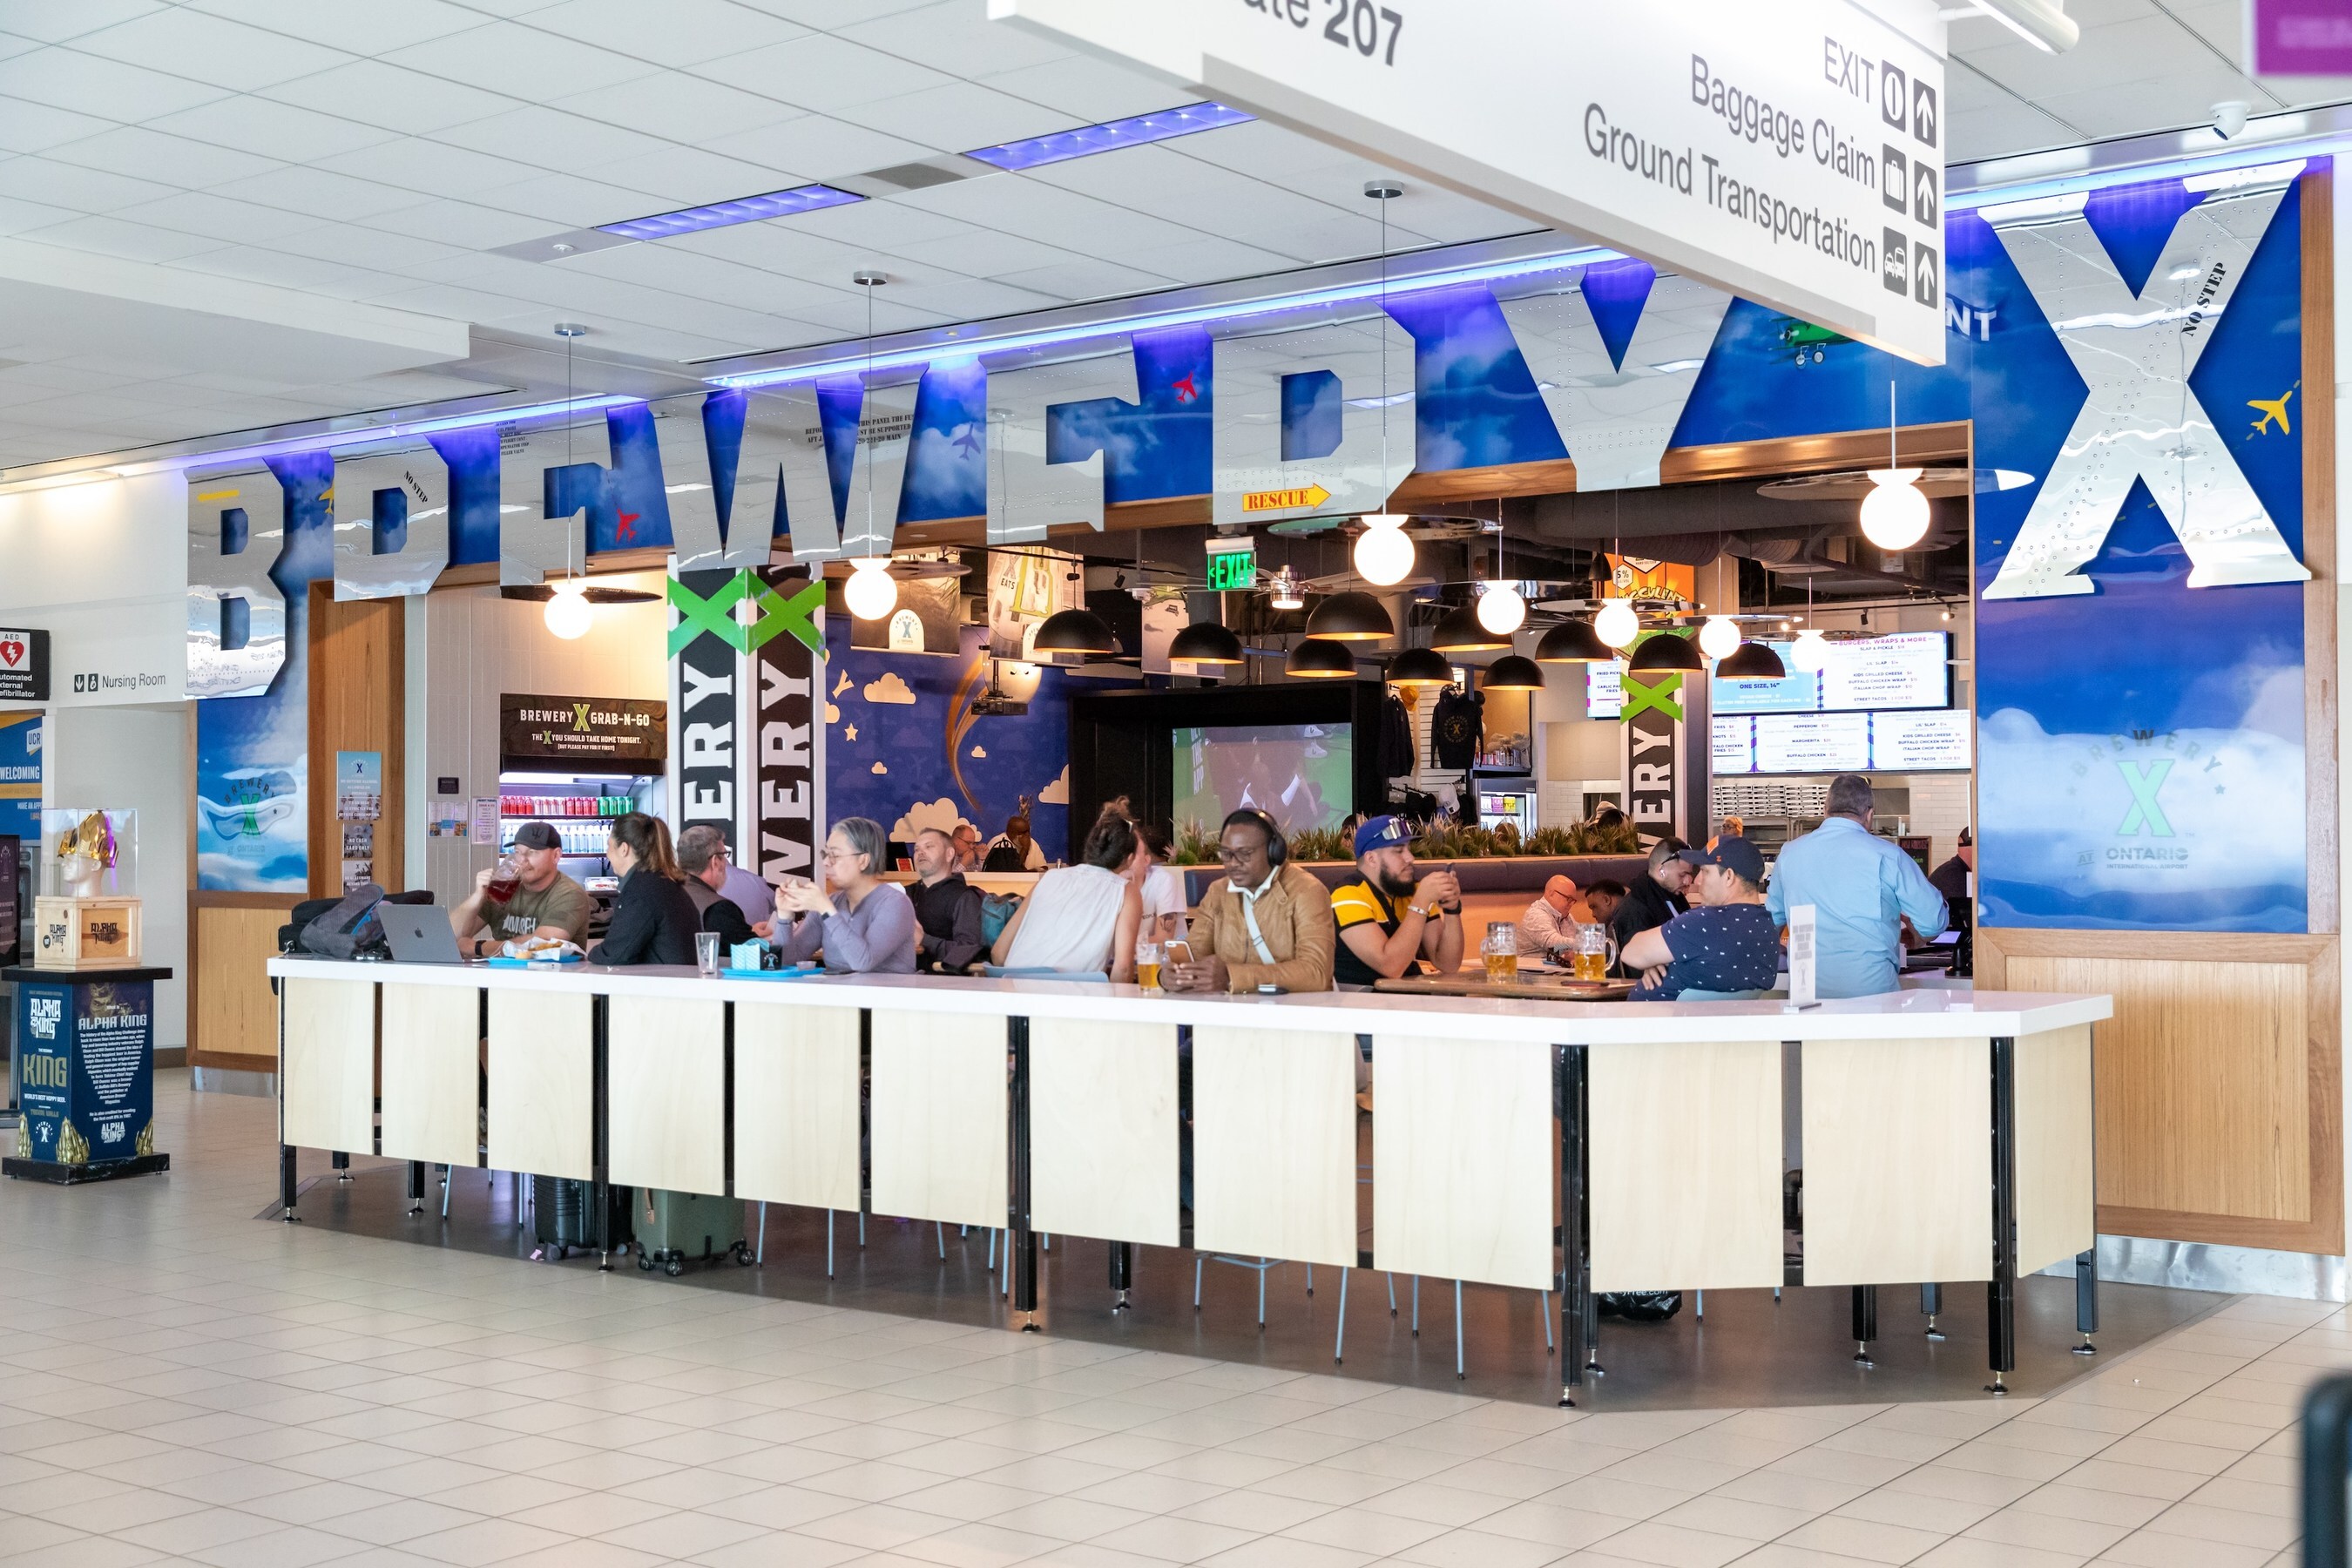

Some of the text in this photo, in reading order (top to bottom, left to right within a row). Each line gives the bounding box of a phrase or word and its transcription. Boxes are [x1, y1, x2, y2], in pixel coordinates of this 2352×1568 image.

[1324, 0, 1402, 67] 207
[1825, 36, 1875, 103] EXIT
[1692, 53, 1875, 189] Baggage Claim
[1585, 103, 1876, 274] Ground Transportation
[2181, 262, 2227, 337] NO STEP
[872, 417, 889, 426] PANEL
[877, 423, 911, 434] SUPPORTED
[404, 470, 428, 503] NO STEP
[1248, 490, 1308, 509] RESCUE
[1215, 553, 1252, 589] EXIT
[1001, 578, 1015, 590] EATS
[102, 673, 166, 689] Nursing Room
[520, 703, 650, 732] BREWERY X GRAB-N-GO
[28, 733, 41, 745] UCR
[543, 730, 552, 745] X
[617, 736, 641, 745] TONIGHT.
[2070, 729, 2223, 777] BREWERY
[0, 766, 40, 780] WELCOMING
[2115, 758, 2177, 838] X
[240, 793, 260, 836] X
[2105, 848, 2189, 861] ONTARIO
[30, 998, 61, 1017] ALPHA
[33, 1017, 61, 1039] KING
[78, 1014, 147, 1030] ALPHA KING
[23, 1054, 67, 1088] KING
[41, 1127, 48, 1142] X
[101, 1121, 125, 1132] ALPHA
[102, 1131, 125, 1139] KING
